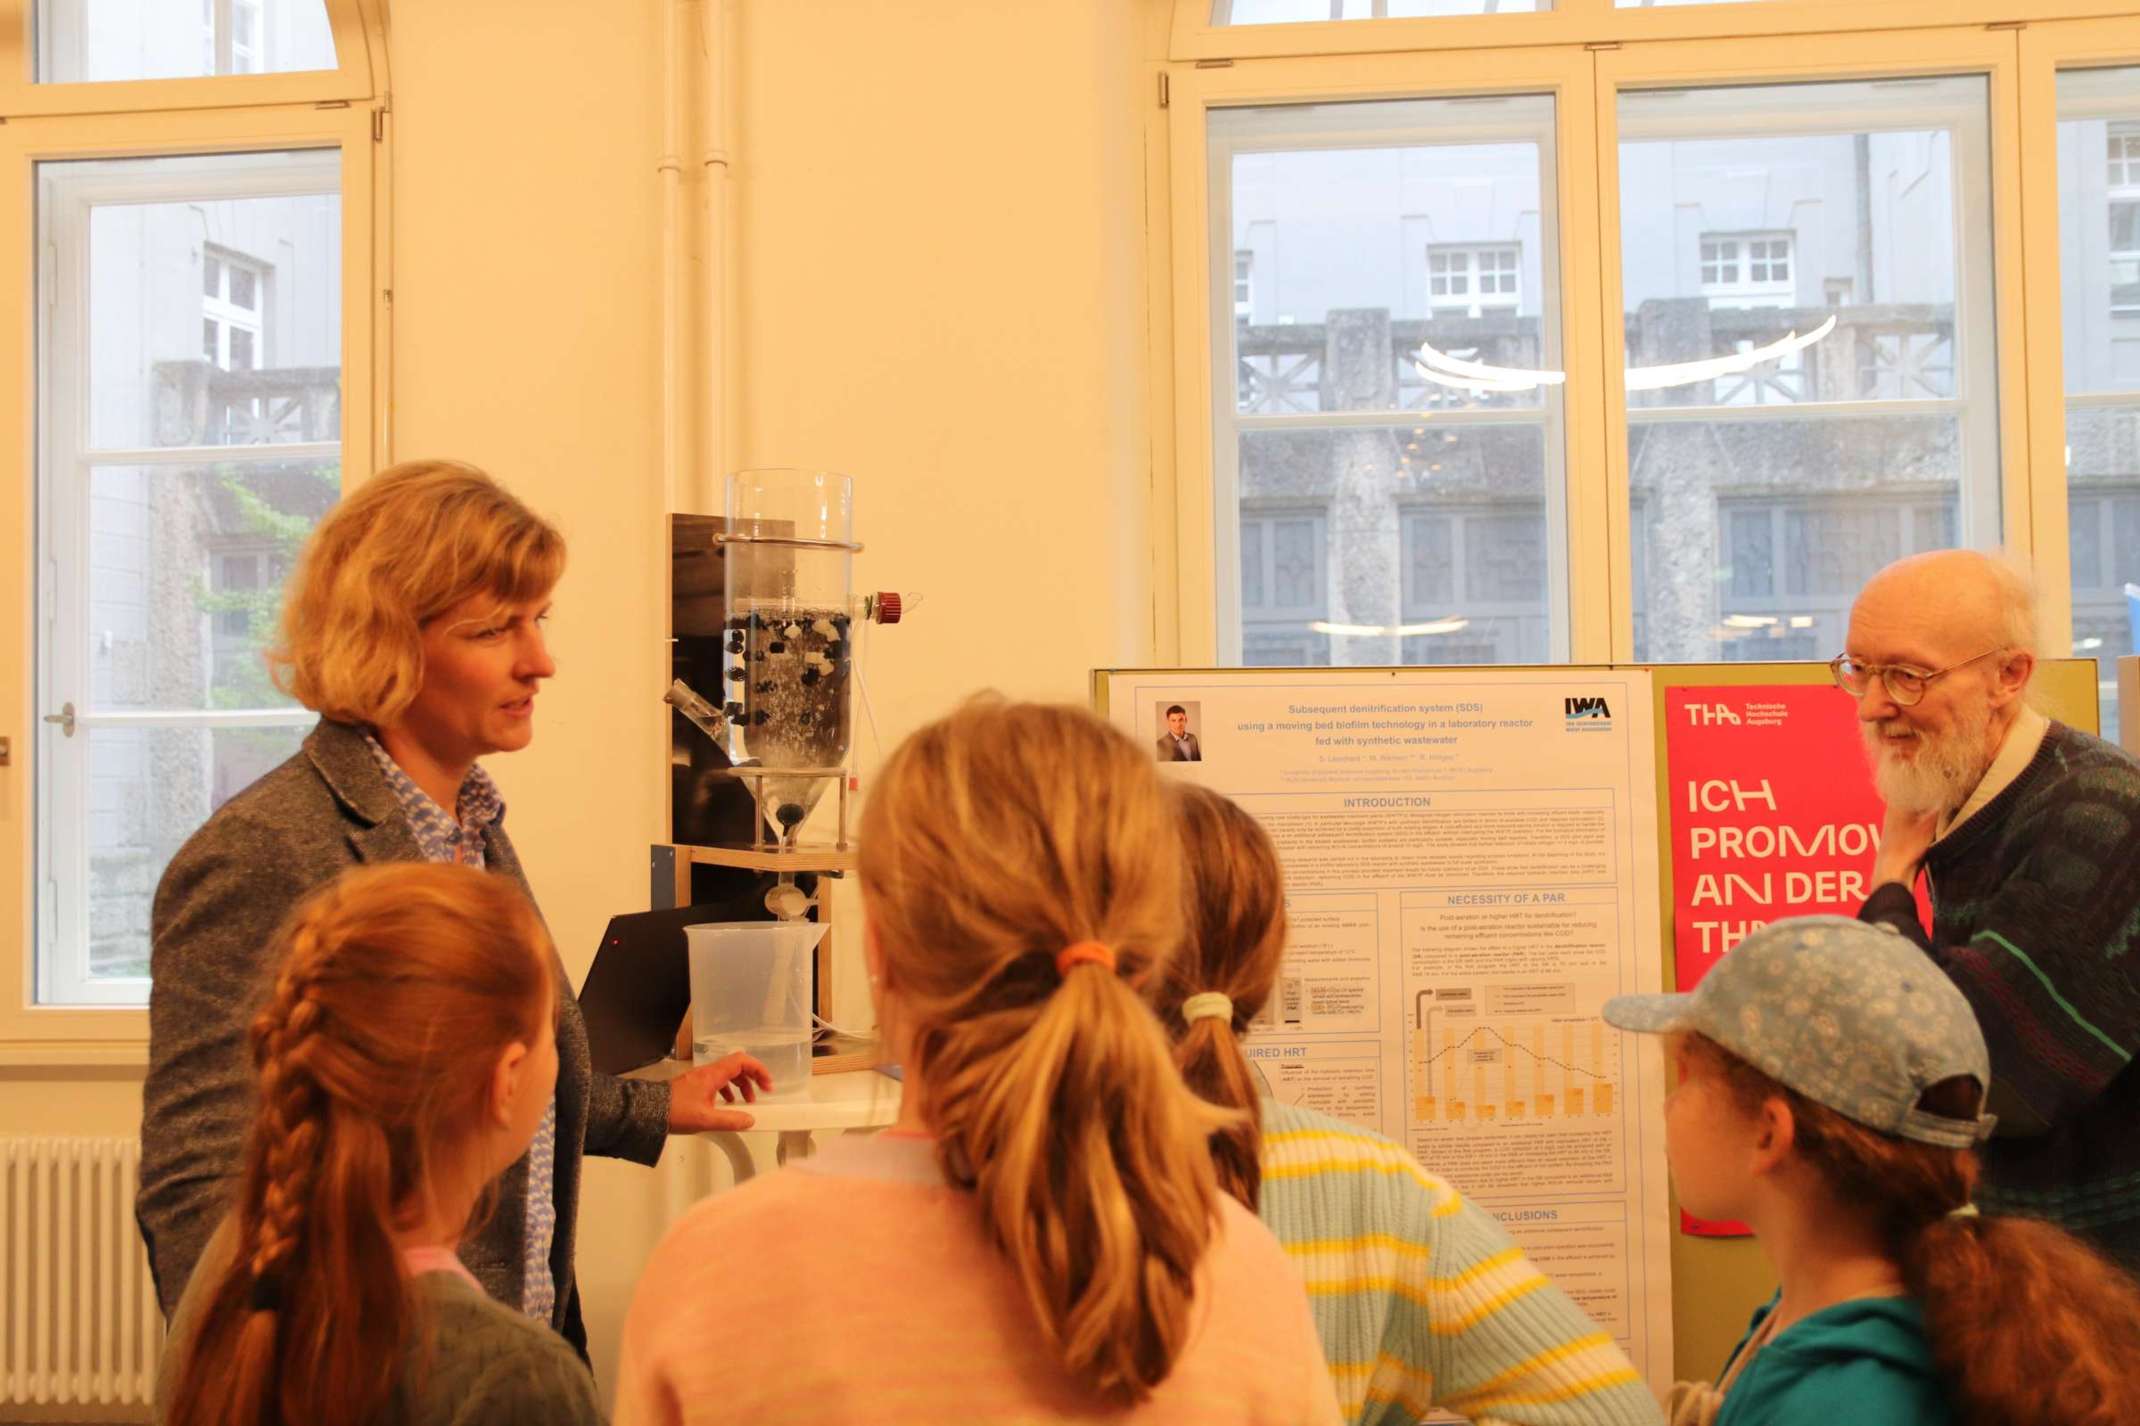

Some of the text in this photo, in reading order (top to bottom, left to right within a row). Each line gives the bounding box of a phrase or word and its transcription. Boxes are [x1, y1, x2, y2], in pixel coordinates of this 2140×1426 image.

[1288, 703, 1483, 715] Subsequent denitrification system (SDS)
[1565, 697, 1611, 718] IWA
[1684, 703, 1741, 726] THA
[1238, 721, 1265, 732] using
[1276, 721, 1312, 732] moving
[1315, 720, 1333, 730] bed
[1336, 720, 1369, 730] biofilm
[1372, 720, 1425, 731] technology
[1428, 720, 1437, 728] in
[1448, 719, 1496, 729] laboratory
[1500, 719, 1532, 728] reactor
[1747, 718, 1782, 726] Augsburg
[1315, 735, 1457, 746] fed with synthetic wastewater
[1688, 779, 1777, 812] ICH
[1344, 797, 1431, 808] INTRODUCTION
[1691, 870, 1870, 906] AN DER
[1448, 893, 1565, 905] NECESSITY OF A PAR
[1283, 1047, 1306, 1057] HRT
